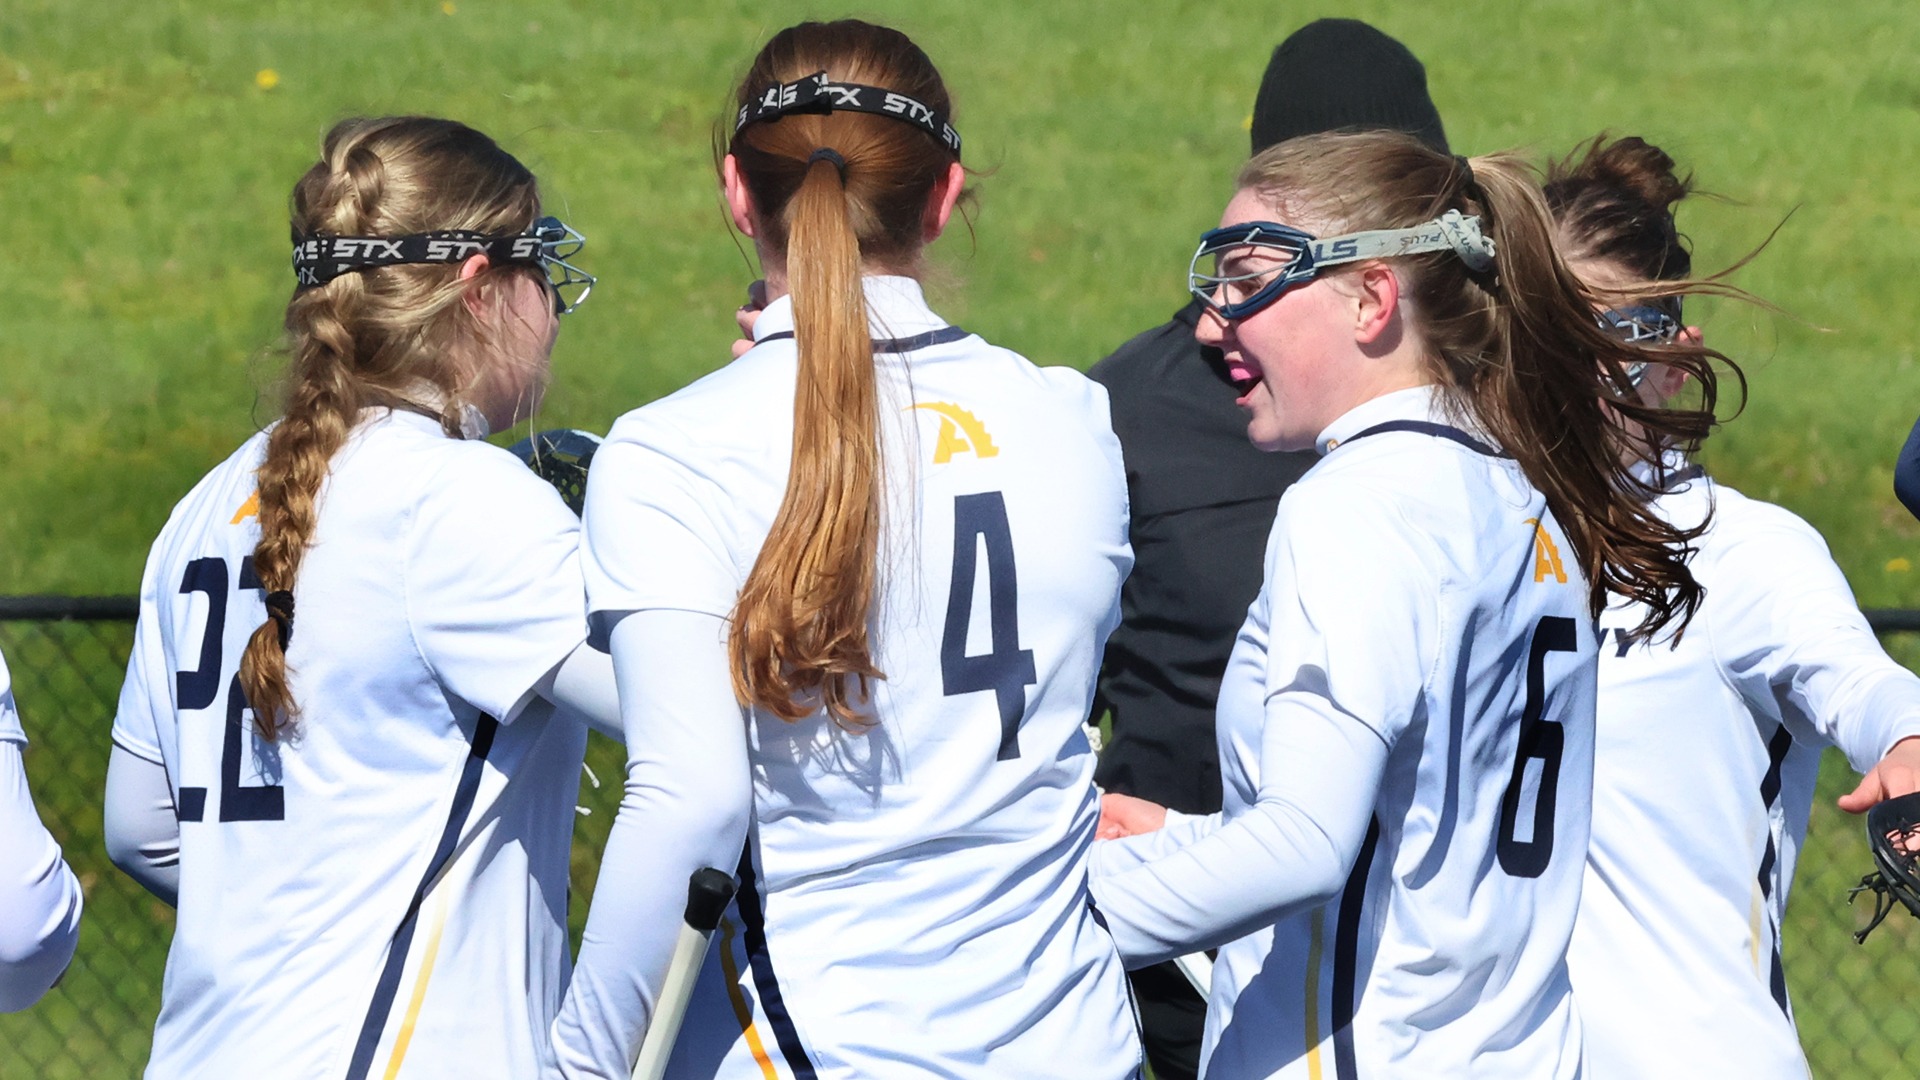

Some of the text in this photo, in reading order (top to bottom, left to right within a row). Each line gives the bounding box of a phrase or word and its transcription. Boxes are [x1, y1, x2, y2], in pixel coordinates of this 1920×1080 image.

[883, 92, 934, 129] STX
[942, 122, 962, 149] ST
[332, 239, 404, 259] STX
[940, 490, 1037, 762] 4
[1496, 615, 1578, 879] 6
